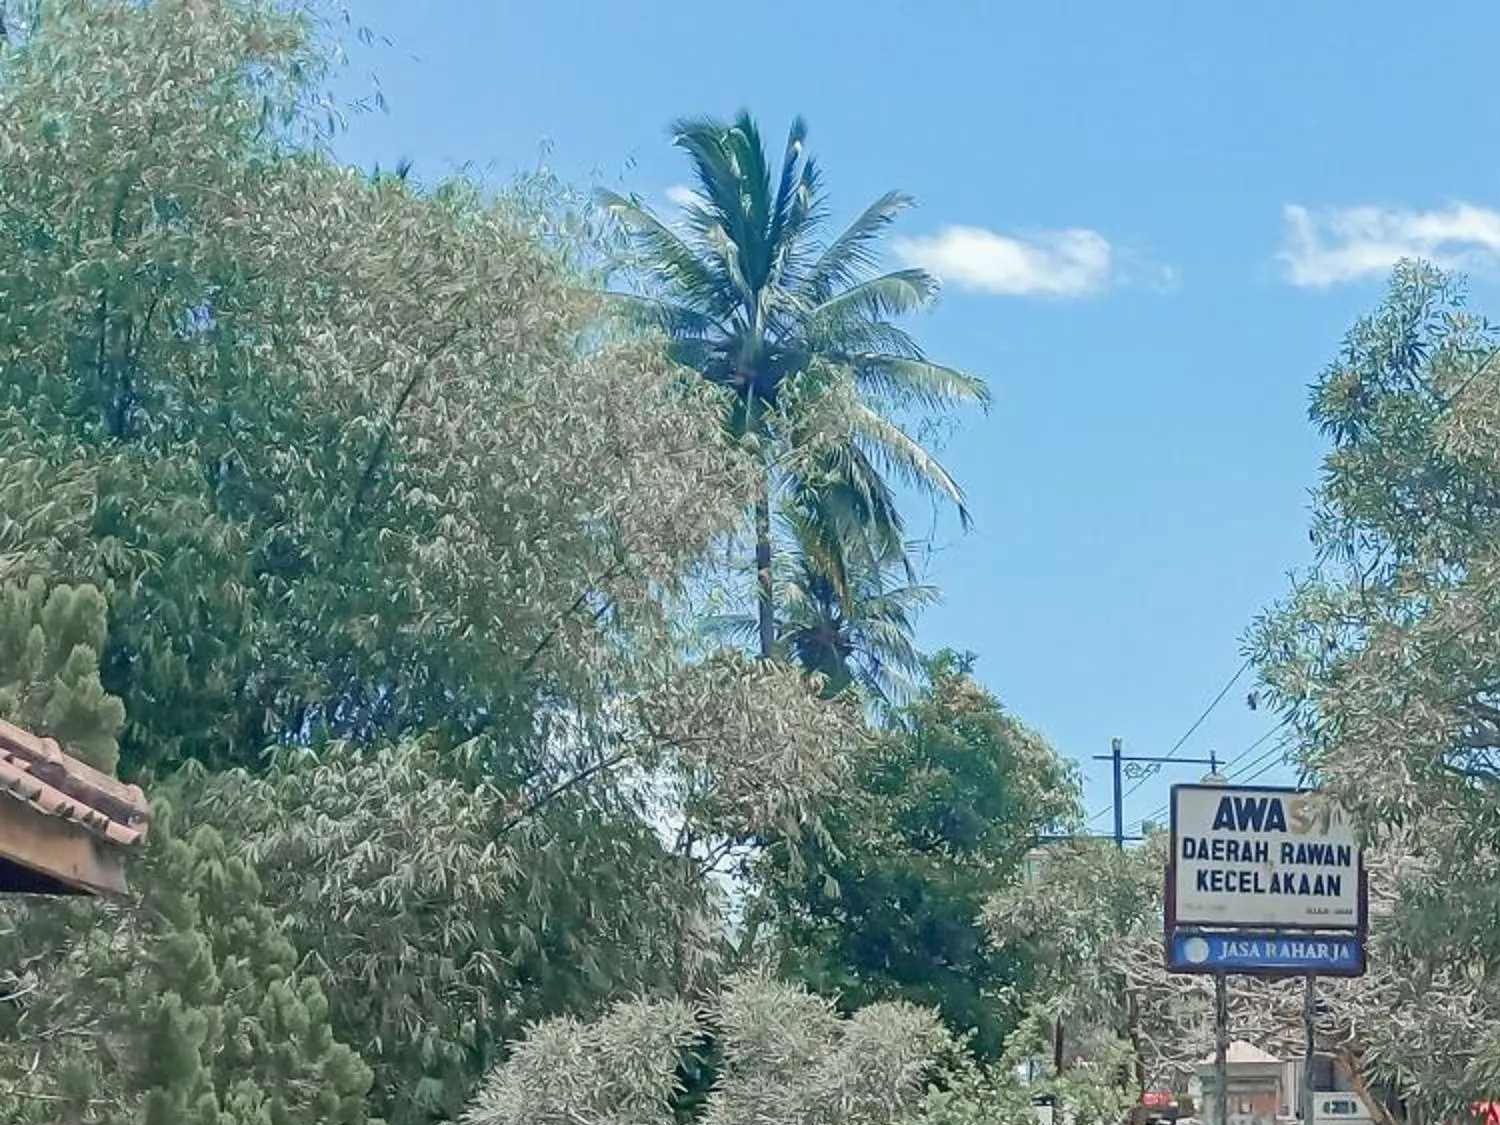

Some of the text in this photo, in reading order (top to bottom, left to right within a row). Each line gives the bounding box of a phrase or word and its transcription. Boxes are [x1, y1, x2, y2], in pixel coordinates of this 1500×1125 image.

[1182, 837, 1351, 867] DAERAH RAWAN
[1196, 870, 1341, 896] KECELAKAAN
[1217, 941, 1349, 961] JASA RAHARJA
